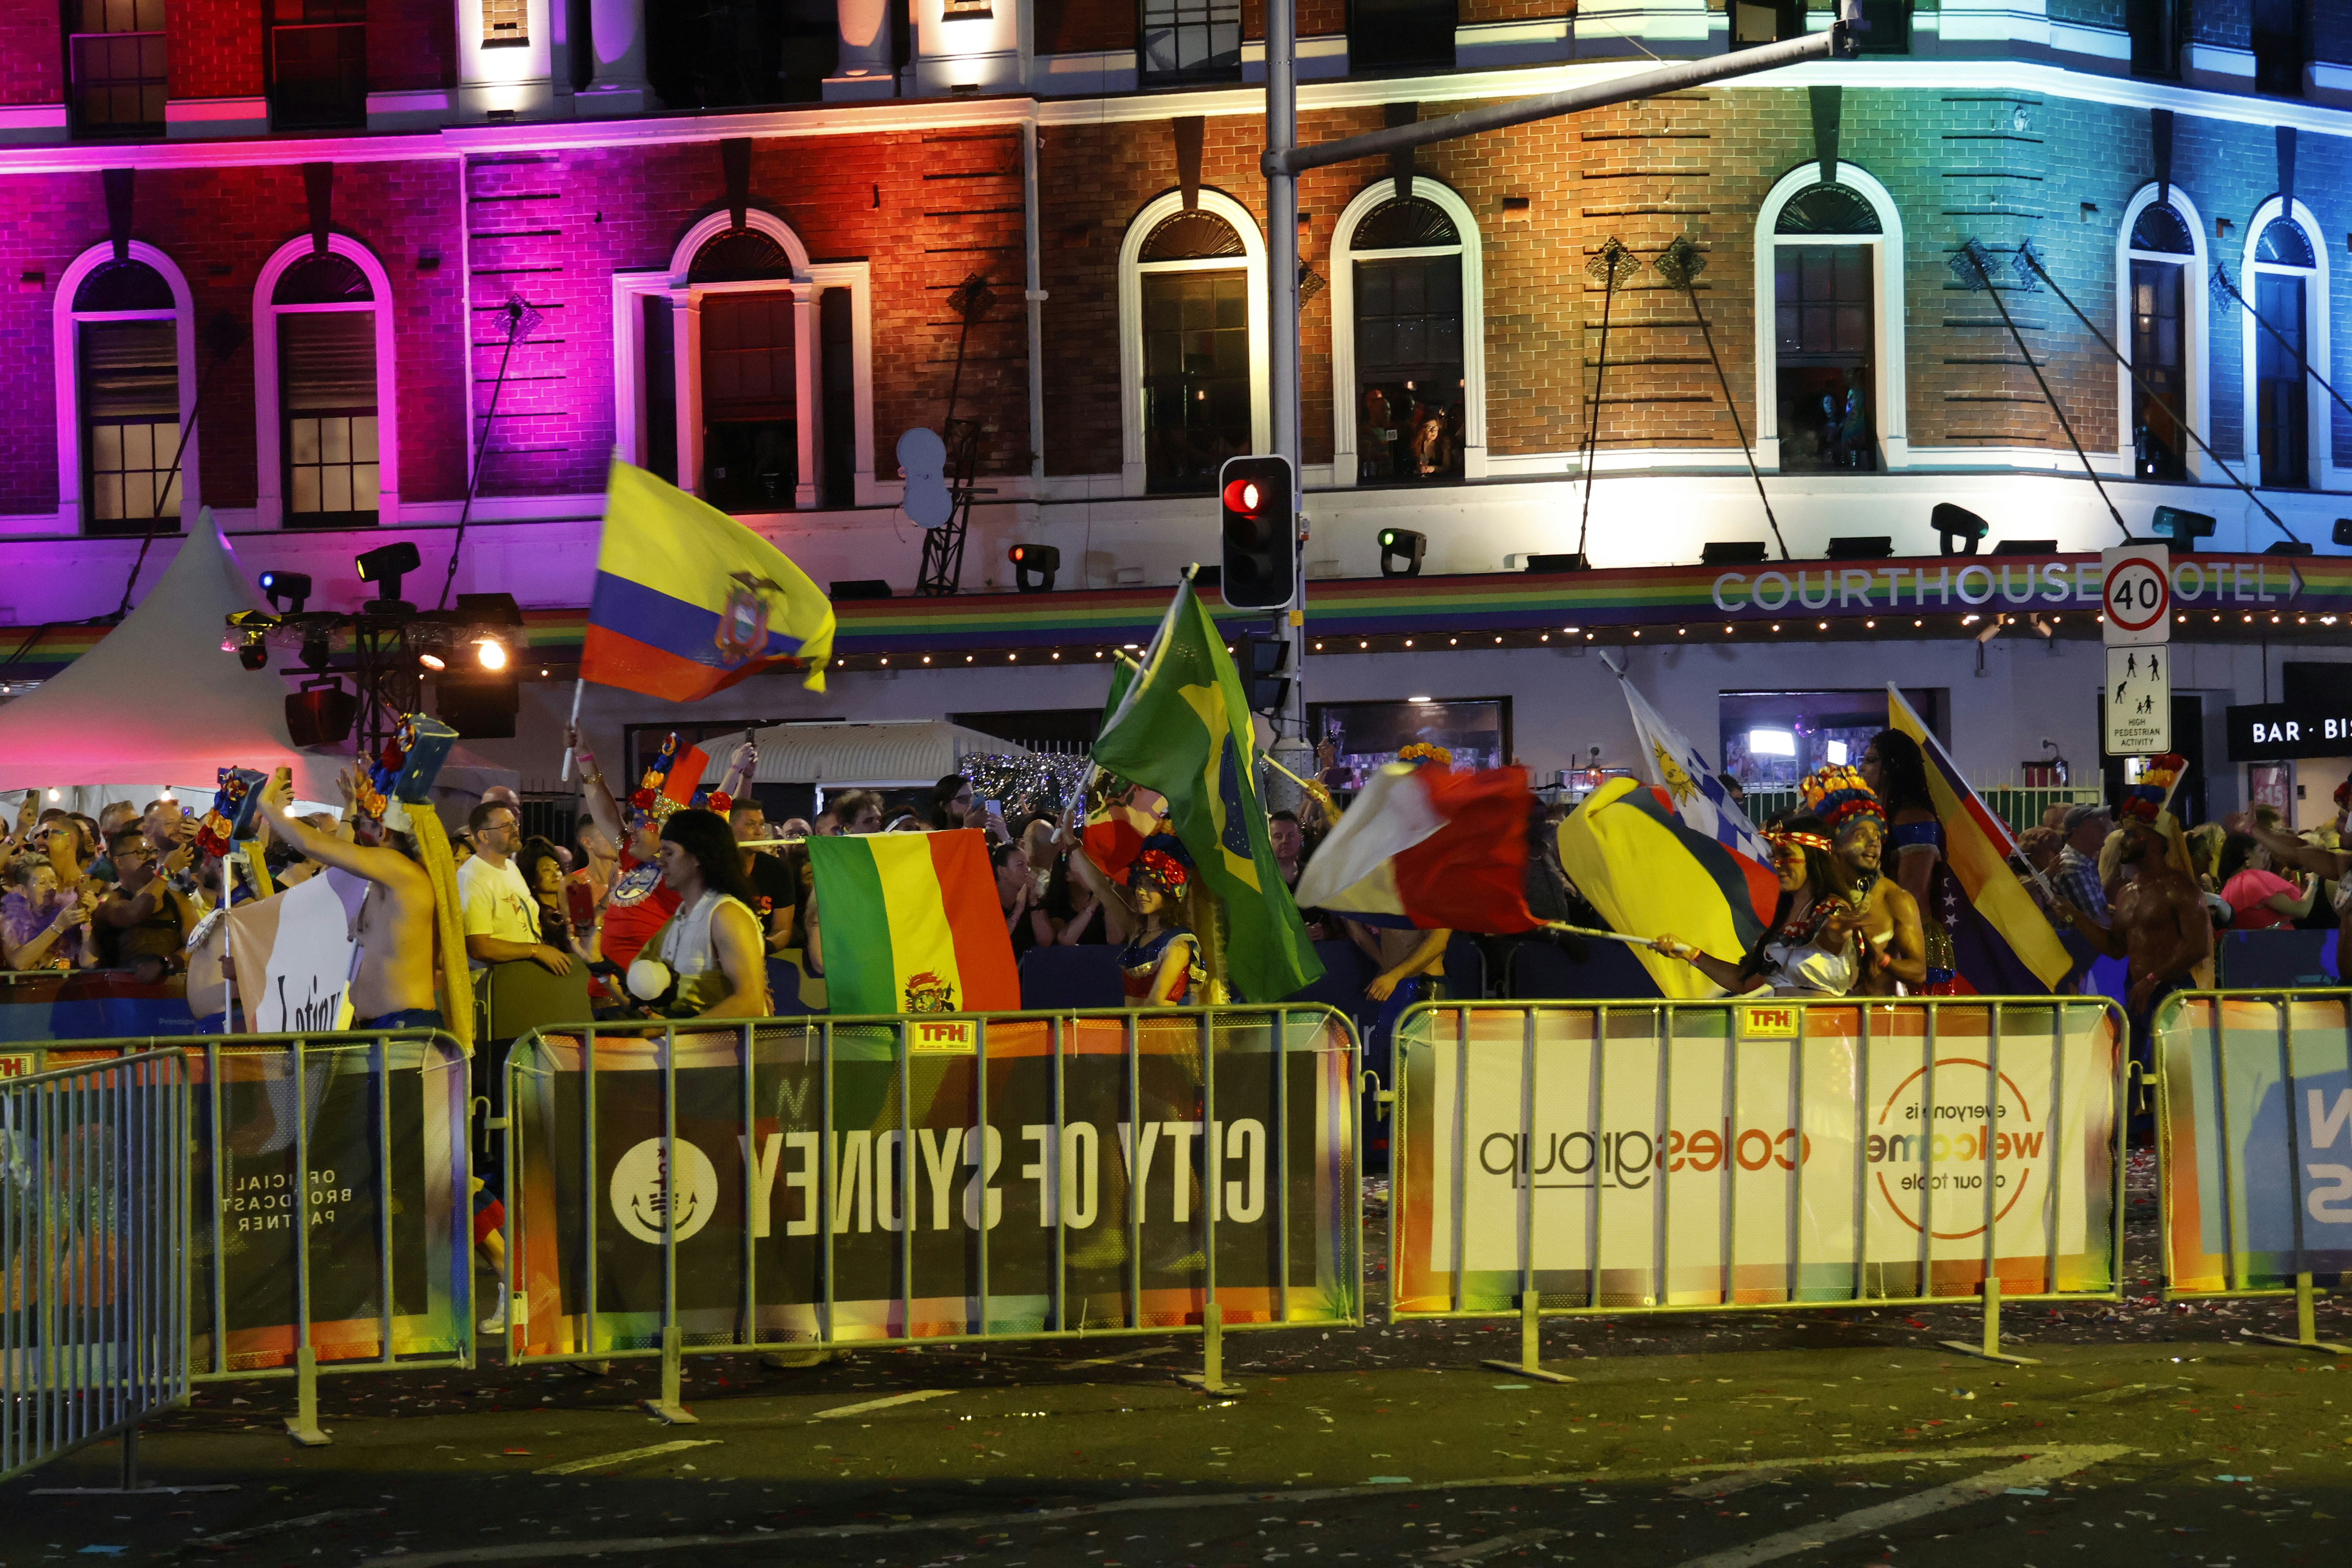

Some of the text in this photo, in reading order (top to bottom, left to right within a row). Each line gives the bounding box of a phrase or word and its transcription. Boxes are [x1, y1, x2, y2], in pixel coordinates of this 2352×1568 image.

[1712, 562, 2276, 612] COURTHOUSE OTEL
[2114, 578, 2158, 610] 40
[2114, 728, 2160, 737] PEDESTRIAN
[2253, 718, 2352, 743] BAR BI
[1751, 1010, 1788, 1026] TFH
[920, 1024, 964, 1041] TFH
